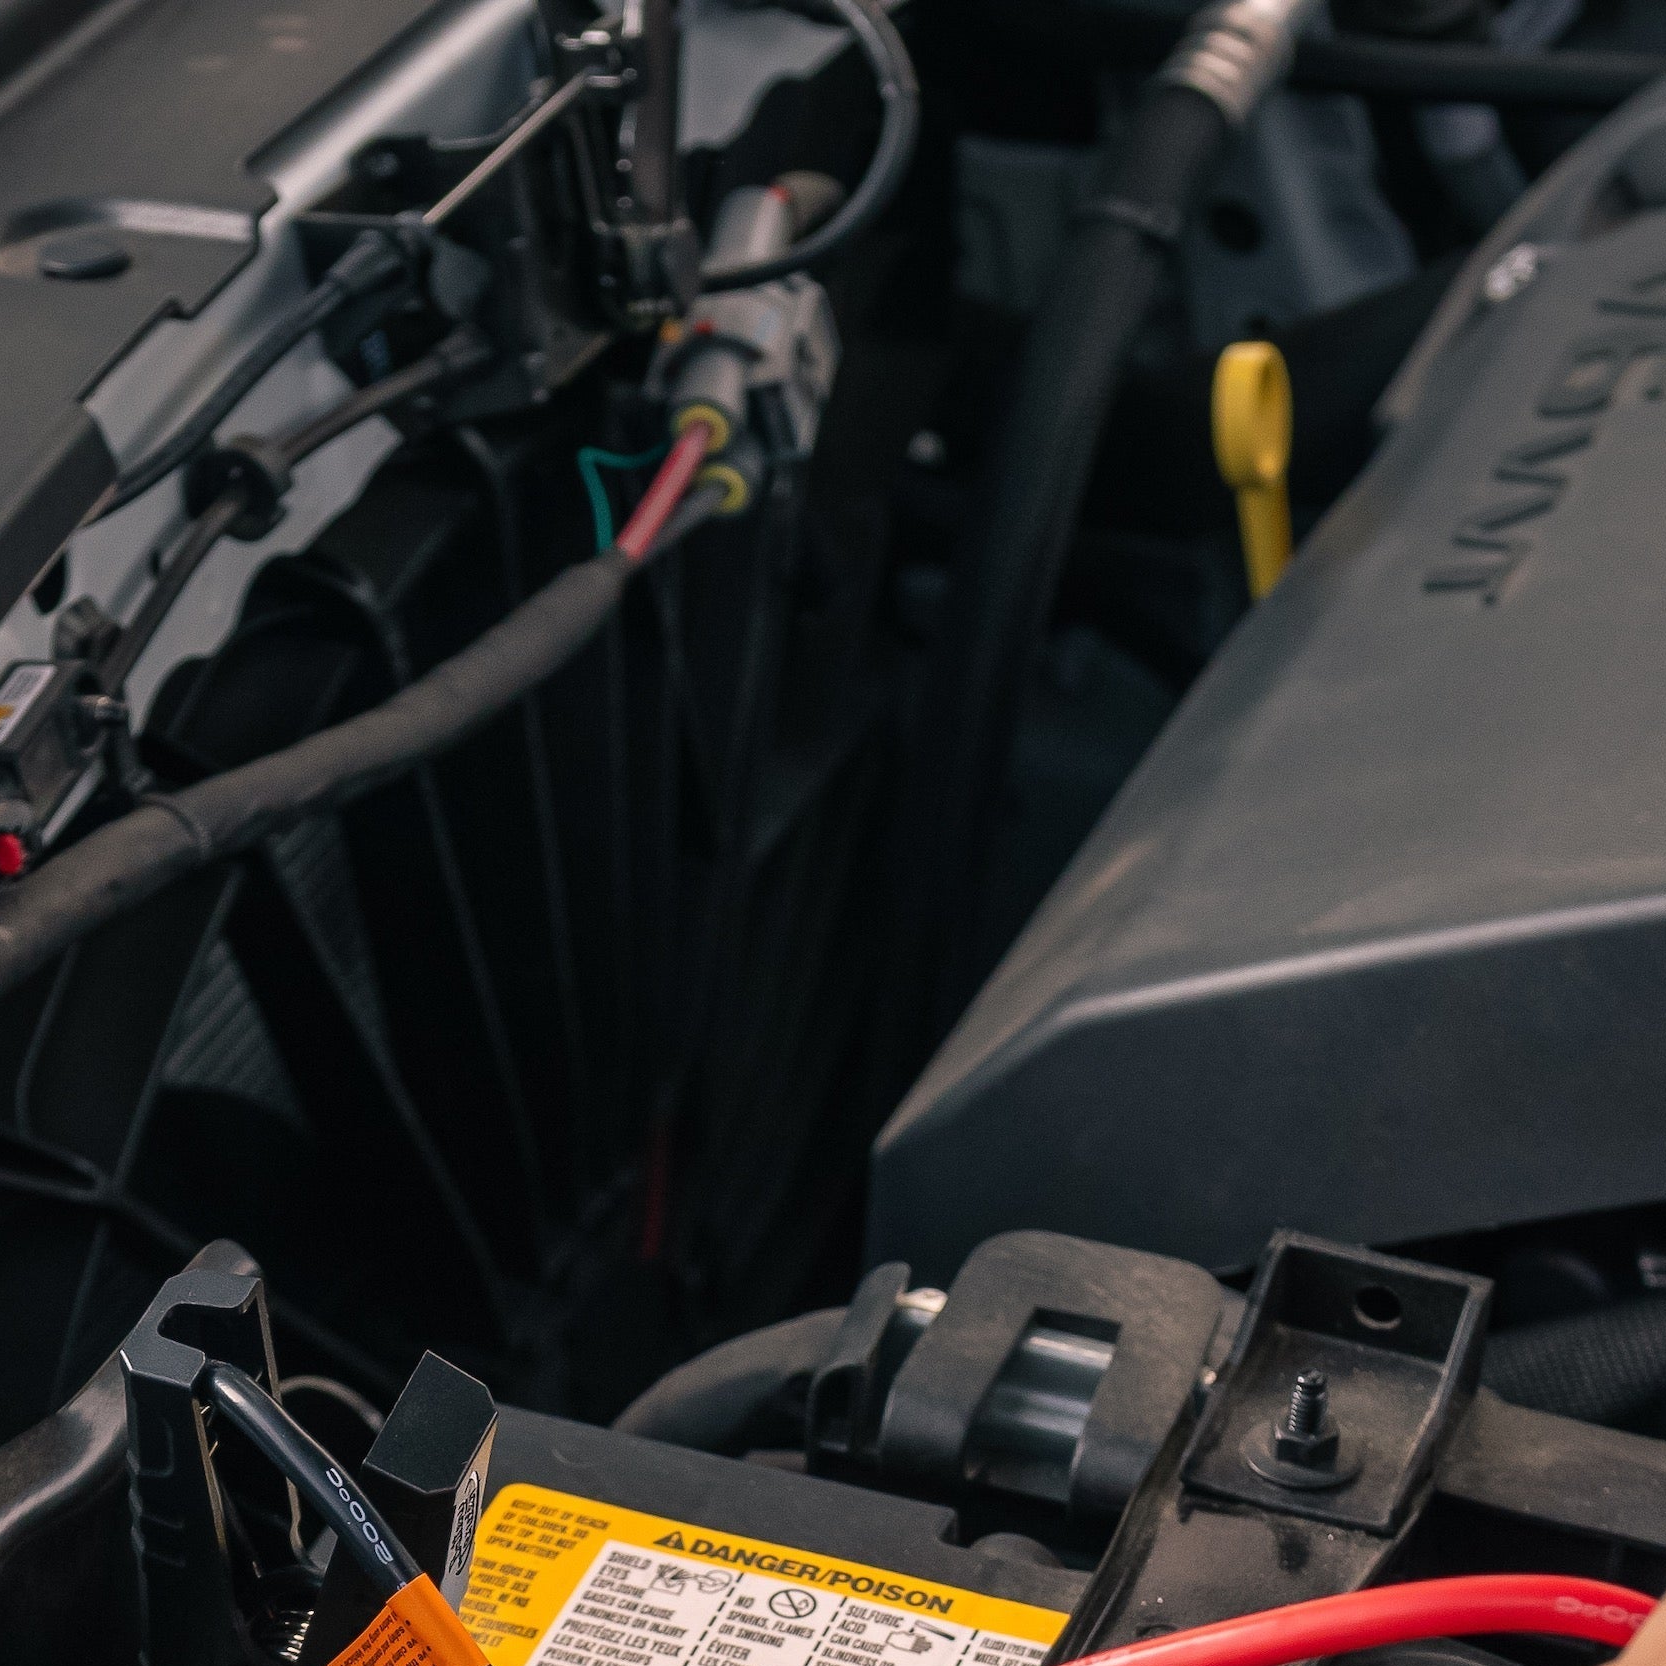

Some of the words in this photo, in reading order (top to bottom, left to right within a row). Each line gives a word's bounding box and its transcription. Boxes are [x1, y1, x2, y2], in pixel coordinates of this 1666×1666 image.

[689, 1537, 955, 1614] DANGER/POISON
[837, 1619, 867, 1635] ACID
[845, 1605, 904, 1628] SULFURIC
[736, 1628, 785, 1648] SMOKING
[772, 1621, 815, 1639] FLAMES
[624, 1634, 649, 1649] LES
[650, 1640, 683, 1657] YEUX
[706, 1638, 751, 1661] ÉVITER
